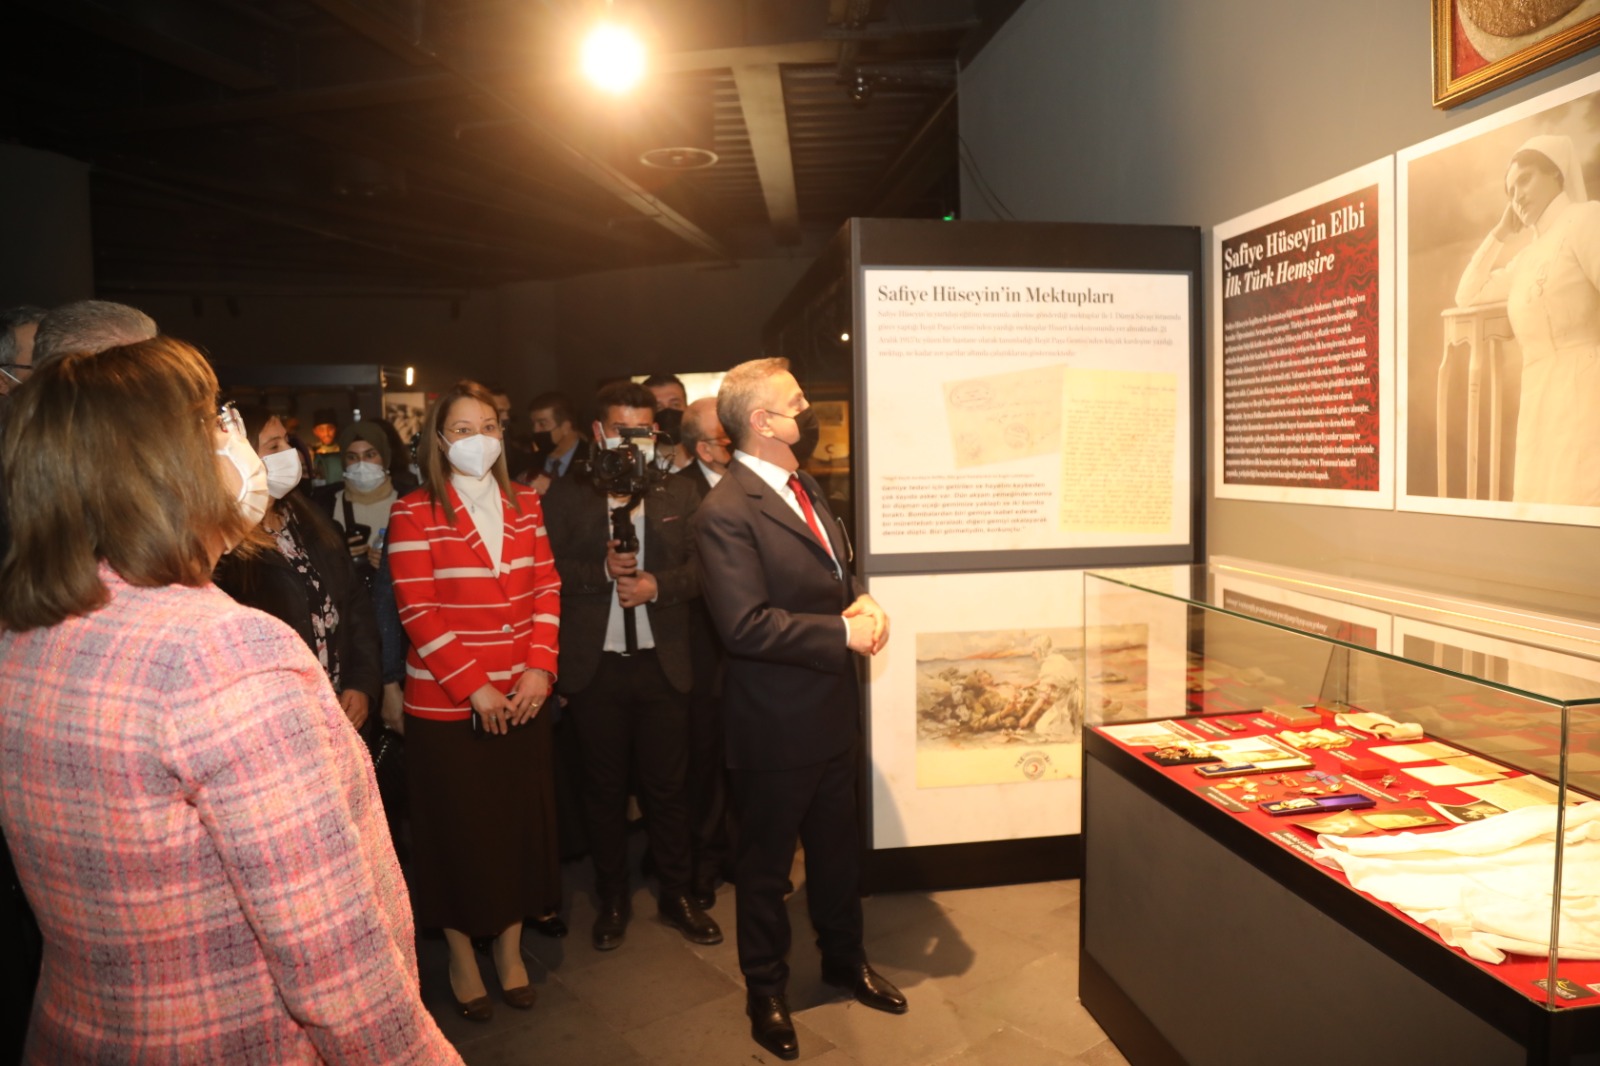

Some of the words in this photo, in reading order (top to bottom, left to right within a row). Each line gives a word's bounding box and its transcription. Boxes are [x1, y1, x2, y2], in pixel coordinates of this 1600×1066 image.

[1224, 242, 1264, 270] Safiye
[1266, 219, 1326, 258] Hüseyin
[1330, 202, 1366, 237] Elbi
[878, 284, 929, 306] Safiye
[1025, 286, 1115, 308] Mektupları
[1224, 272, 1241, 299] İlk
[1244, 265, 1274, 294] Türk
[1276, 251, 1335, 283] Hemşire
